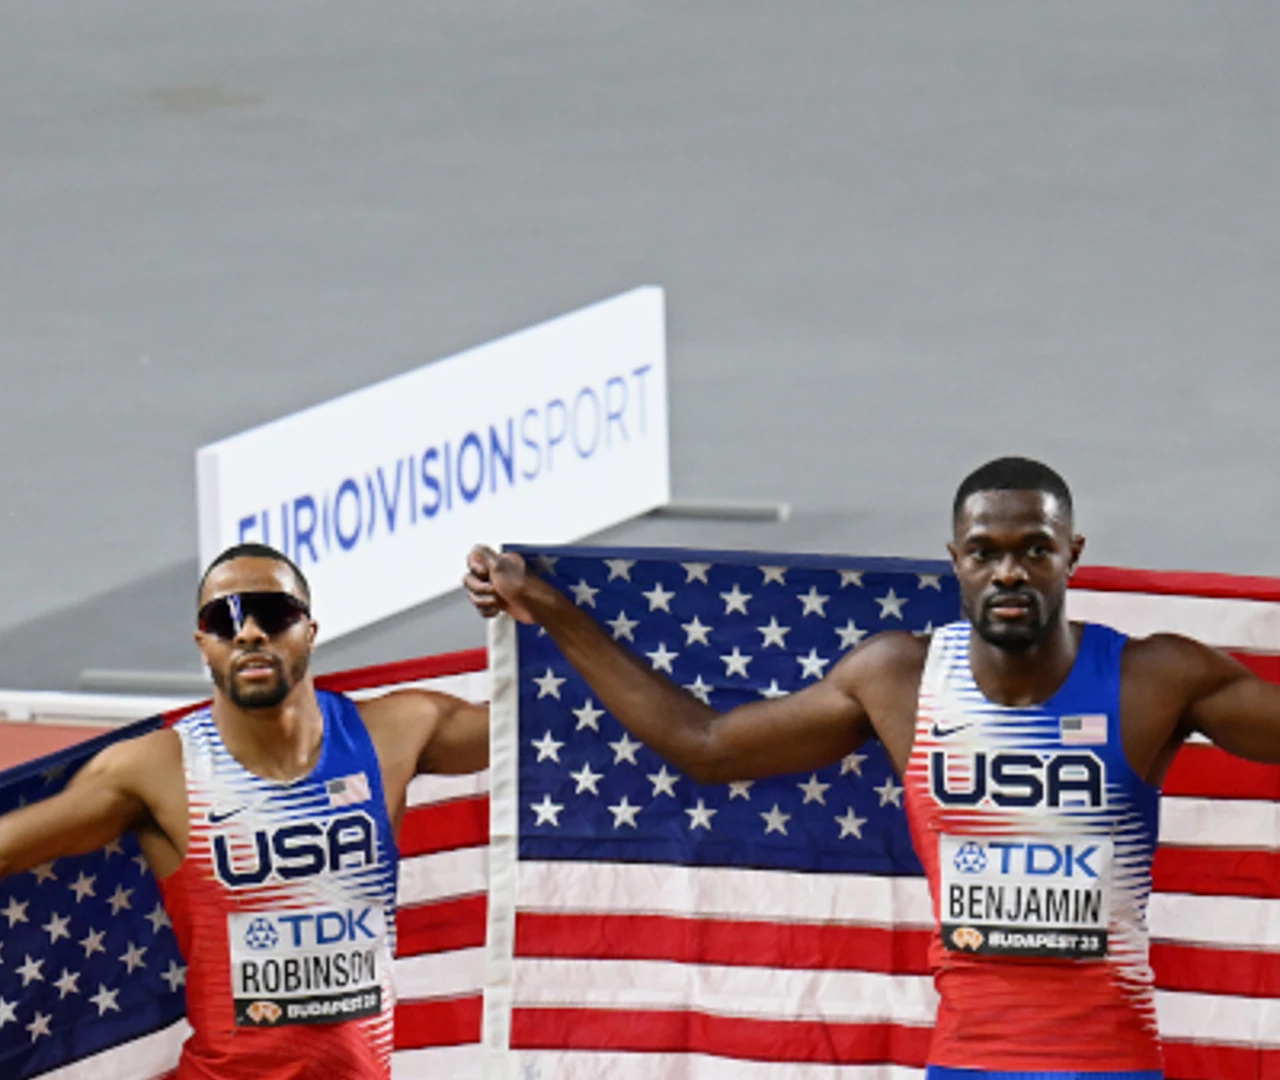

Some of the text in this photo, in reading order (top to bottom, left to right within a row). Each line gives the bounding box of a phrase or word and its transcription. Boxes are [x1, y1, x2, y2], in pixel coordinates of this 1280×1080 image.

[931, 751, 1102, 808] USA
[213, 814, 375, 886] USA
[988, 841, 1100, 878] TDK
[949, 884, 1102, 923] BENJAMIN
[277, 907, 377, 947] TDK
[242, 949, 376, 993] ROBINSON
